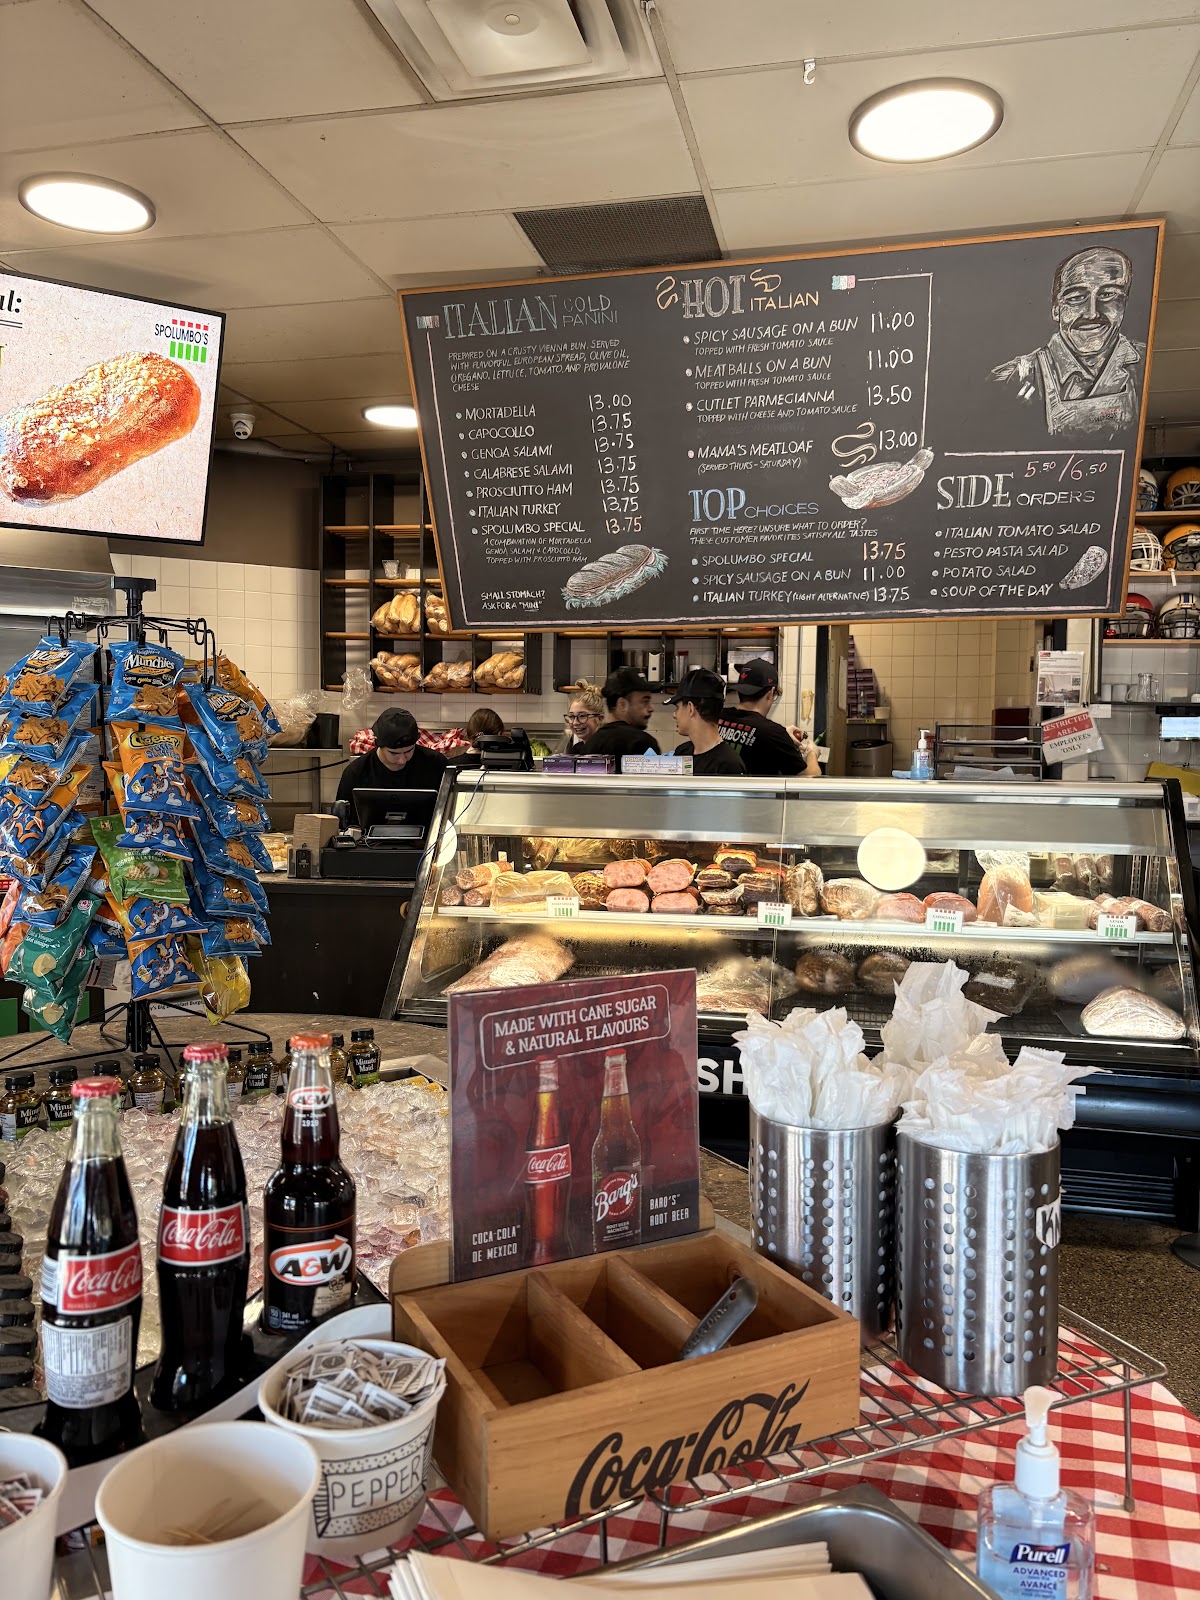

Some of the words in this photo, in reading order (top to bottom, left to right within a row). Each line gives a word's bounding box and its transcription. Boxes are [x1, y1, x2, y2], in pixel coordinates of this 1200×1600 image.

[682, 275, 745, 319] HOT
[750, 291, 819, 312] ITALIAN
[442, 295, 558, 338] ITALIAN
[564, 295, 611, 313] COLD
[563, 310, 618, 327] PANINI
[155, 323, 209, 345] SPOLUMBO'S
[694, 330, 728, 345] SPICY
[731, 324, 788, 341] SAUSAGE
[793, 322, 814, 335] ON
[817, 323, 825, 333] A
[829, 317, 858, 332] BUN
[871, 312, 915, 333] 11.00
[449, 351, 484, 361] PREPARED
[486, 349, 498, 358] ON
[507, 344, 537, 355] CRUSTY
[539, 343, 568, 352] VIENNA
[571, 341, 589, 350] BUN.
[591, 339, 620, 349] SERVED
[695, 346, 724, 355] TOPPED
[725, 345, 746, 354] WITH
[747, 343, 769, 352] FRESH
[771, 340, 804, 350] TOMATO
[808, 338, 834, 347] SAUCE
[451, 361, 470, 371] WITH
[514, 355, 554, 366] EUROPEAN
[556, 353, 586, 362] SPREAD,
[589, 350, 611, 360] OLIVE
[614, 348, 629, 358] OIL,
[695, 360, 762, 379] MEATBALLS
[766, 359, 787, 373] ON
[790, 358, 799, 370] A
[803, 355, 832, 369] BUN
[868, 348, 913, 370] 11.00
[451, 372, 491, 383] OREGANO,
[493, 369, 526, 379] LETTUCE,
[565, 363, 581, 372] AND
[453, 383, 480, 392] CHEESE
[466, 404, 537, 420] MORTADELLA
[589, 394, 632, 412] 13.00
[697, 396, 741, 412] CUTLET
[867, 385, 912, 406] 13.50
[697, 414, 725, 423] TOPPED
[728, 411, 748, 421] WITH
[750, 410, 776, 419] CHEESE
[777, 409, 794, 418] AND
[796, 406, 830, 417] TOMATO
[832, 404, 857, 414] SAUCE
[468, 425, 535, 441] CAPOCOLLO
[591, 412, 632, 433] 13.75
[472, 446, 510, 459] GENOA
[513, 444, 552, 456] SALAMI
[594, 433, 635, 453] 13.75
[698, 445, 747, 459] MAMA'S
[750, 440, 814, 456] MEATLOAF
[879, 430, 917, 451] 13.00
[473, 467, 531, 479] CALABRESE
[533, 464, 573, 476] SALAMI
[598, 456, 637, 475] 13.75
[476, 486, 543, 498] PROSCIUTTO
[546, 483, 573, 495] HAM
[601, 475, 640, 494] 13.75
[936, 472, 1014, 510] SIDE
[1016, 490, 1096, 507] ORDERS
[478, 506, 519, 518] ITALIAN
[521, 503, 561, 516] TURKEY
[602, 496, 639, 513] 13.75
[688, 487, 746, 522] TOP
[744, 502, 819, 519] CHOICES
[482, 524, 540, 535] SPOLUMBO
[543, 521, 585, 532] SPECIAL
[606, 516, 643, 534] 13.75
[945, 526, 993, 539] ITALIAN
[998, 524, 1054, 537] TOMATO
[1057, 523, 1100, 535] SALAD
[702, 554, 766, 566] SPOLUMBO
[770, 551, 814, 564] SPECIAL
[863, 541, 905, 561] 13.75
[943, 546, 983, 559] PESTO
[986, 546, 1023, 557] PASTA
[1026, 544, 1068, 556] SALAD
[703, 573, 732, 585] SPICY
[736, 572, 787, 584] SAUSAGE
[791, 571, 810, 581] ON
[814, 571, 822, 580] A
[825, 568, 852, 580] BUN
[863, 565, 905, 581] 11.00
[943, 566, 992, 577] POTATO
[996, 565, 1036, 576] SALAD
[481, 591, 505, 600] SMALL
[507, 590, 546, 599] STOMACH?
[703, 591, 745, 603] ITALIAN
[748, 590, 792, 602] TURKEY
[874, 587, 910, 603] 13.75
[942, 585, 976, 598] SOUP
[979, 585, 996, 596] OF
[998, 584, 1025, 596] THE
[1028, 583, 1054, 596] DAY
[482, 601, 497, 610] ASK
[124, 654, 174, 671] Munchies
[1043, 714, 1089, 732] RESTRICTED
[1057, 726, 1078, 737] AREA
[1050, 732, 1091, 749] EMPLOYEES
[1062, 744, 1082, 754] ONLY
[494, 1019, 535, 1038] MADE
[539, 1011, 577, 1030] WITH
[579, 1003, 613, 1023] CANE
[615, 996, 656, 1017] SUGAR
[505, 1042, 516, 1056] &
[518, 1031, 583, 1054] NATURAL
[586, 1015, 649, 1041] FLAVOURS
[356, 1058, 377, 1066] Minute
[359, 1064, 374, 1072] Maid
[296, 1094, 332, 1105] A&W
[527, 1152, 568, 1174] Coca-Cola
[595, 1173, 638, 1221] Barq's
[650, 1212, 668, 1226] ROOT
[672, 1208, 689, 1222] BEER
[162, 1215, 237, 1250] Coca-Cola
[472, 1225, 518, 1246] COCA-COLA
[280, 1247, 349, 1277] A&W
[472, 1250, 482, 1262] DE
[487, 1242, 518, 1260] MEXICO
[565, 1379, 811, 1519] Coca-Cola
[330, 1454, 422, 1512] PEPPER
[1017, 1545, 1066, 1563] Purell
[1013, 1567, 1066, 1578] ADVANCED
